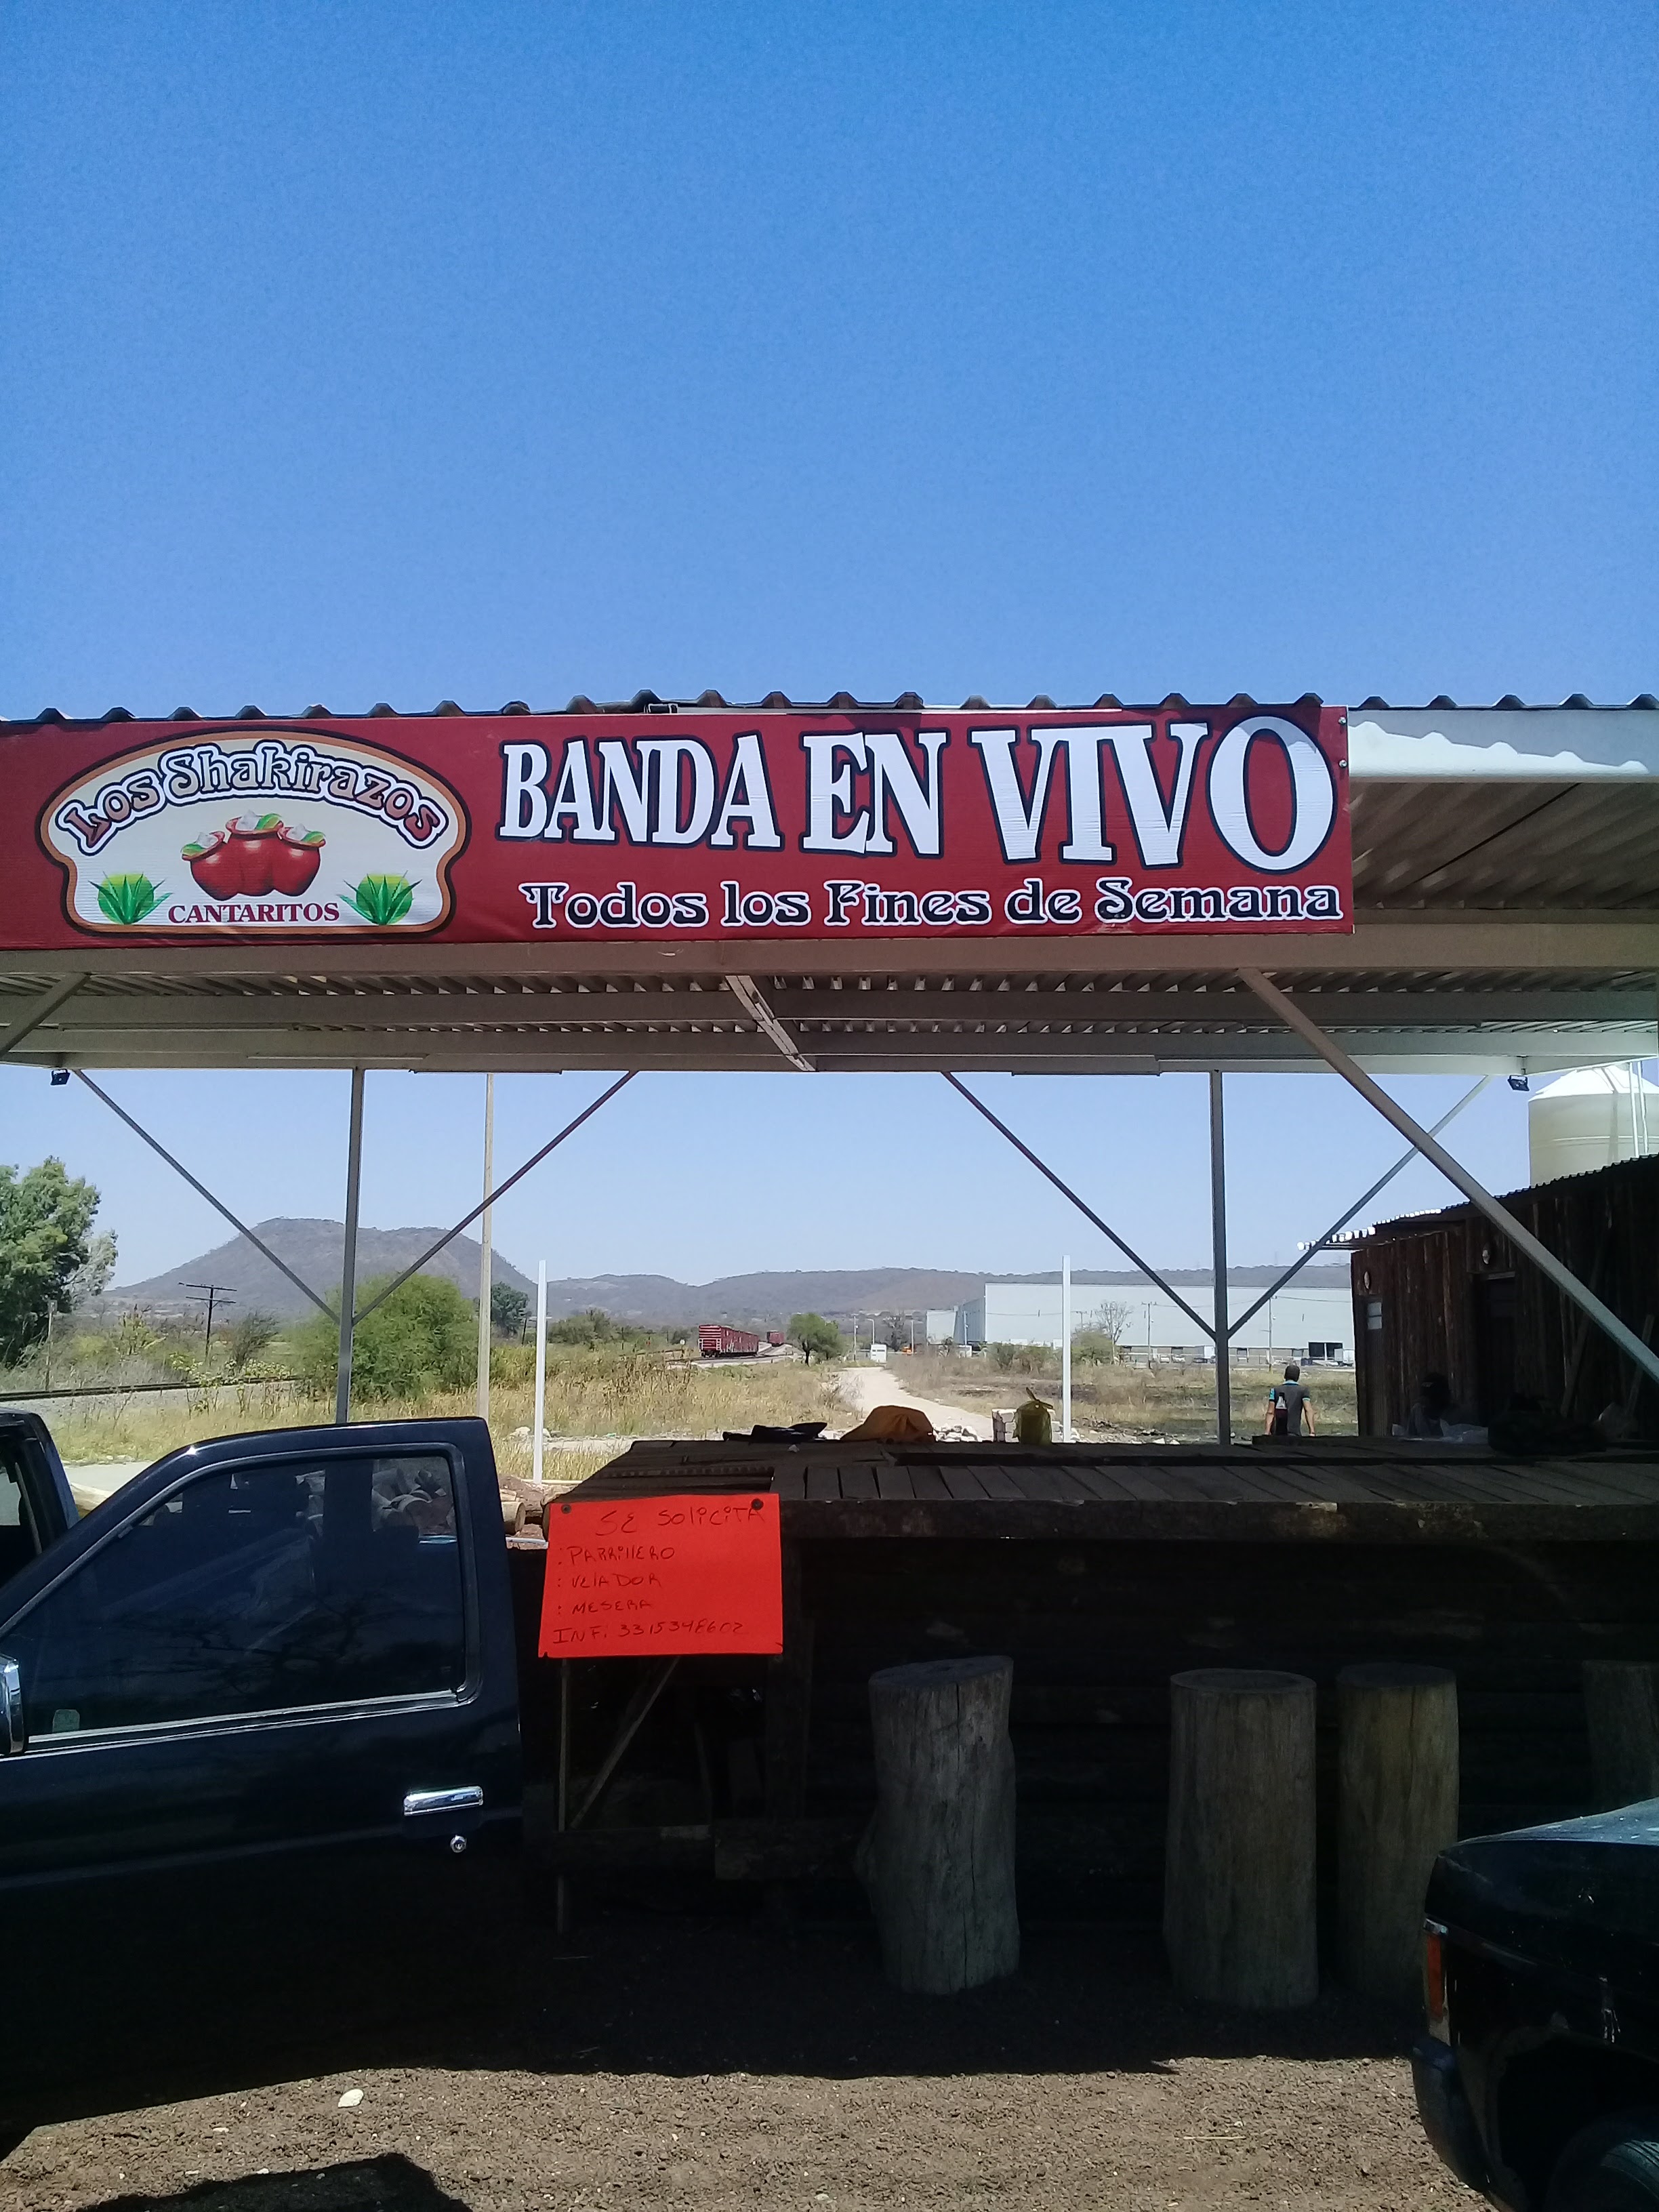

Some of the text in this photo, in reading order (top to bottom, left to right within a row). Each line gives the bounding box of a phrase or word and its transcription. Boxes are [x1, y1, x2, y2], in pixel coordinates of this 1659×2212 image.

[60, 743, 445, 852] Los Shakirazos
[499, 716, 1334, 871] BANDA EN VIVO
[167, 902, 340, 924] CANTARITOS
[519, 877, 1344, 928] Todos los Fines de Semana
[596, 1510, 638, 1536] SE
